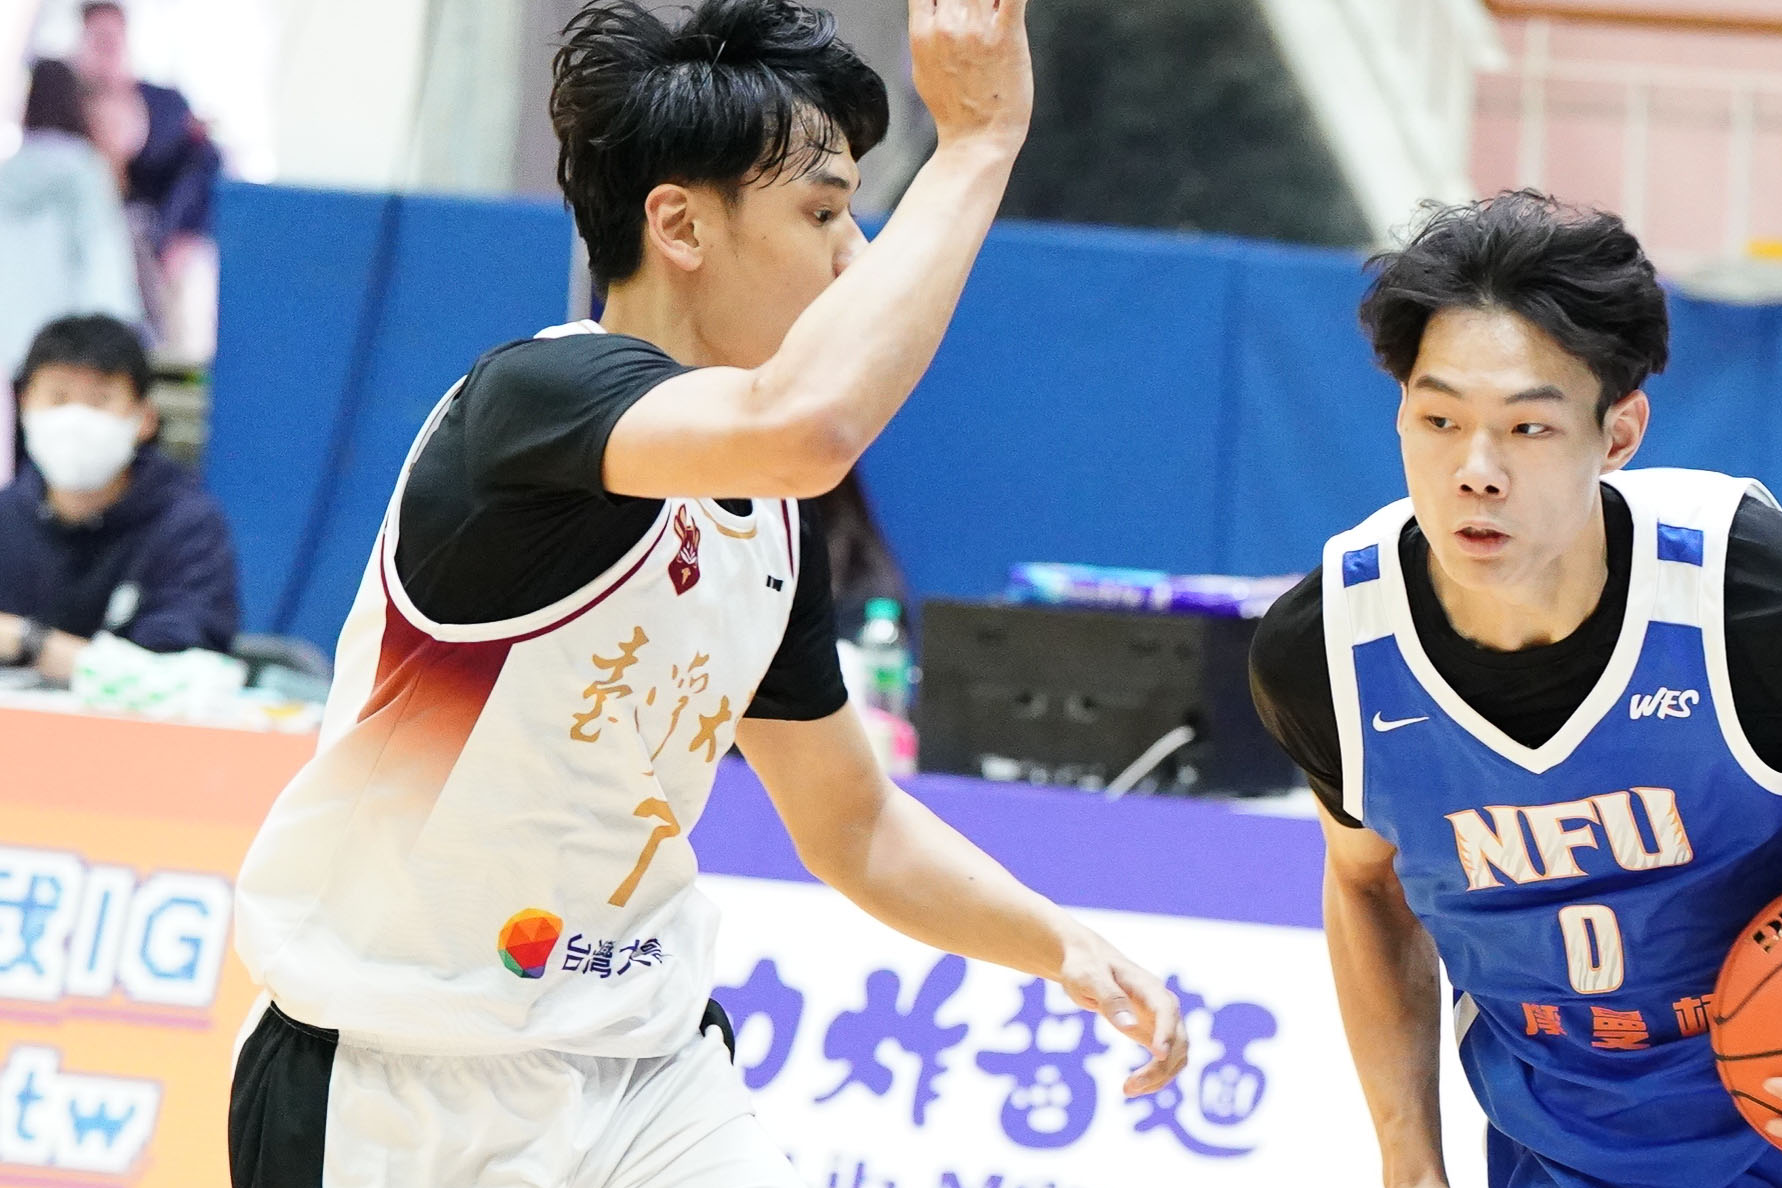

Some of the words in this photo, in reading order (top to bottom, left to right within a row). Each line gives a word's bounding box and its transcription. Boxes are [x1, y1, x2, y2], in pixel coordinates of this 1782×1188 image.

[1629, 686, 1700, 720] WES
[607, 796, 682, 907] 7
[1444, 786, 1694, 891] NFU
[1558, 904, 1626, 995] 0
